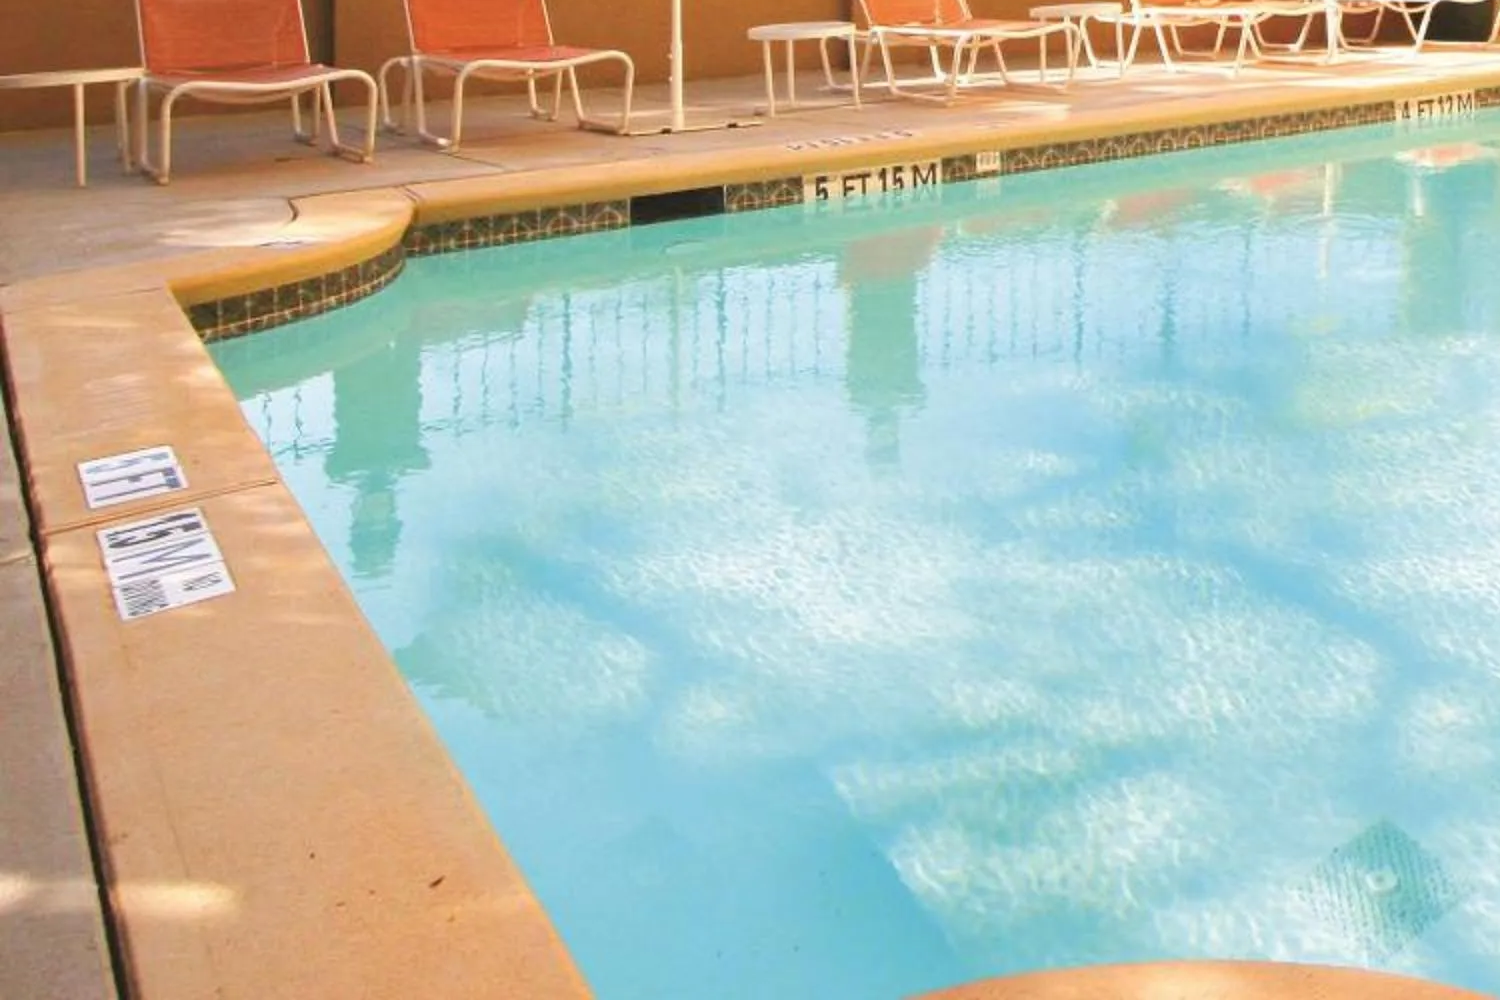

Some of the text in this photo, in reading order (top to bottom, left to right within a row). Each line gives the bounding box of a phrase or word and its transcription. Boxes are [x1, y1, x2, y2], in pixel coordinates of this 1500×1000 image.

[815, 175, 829, 201] 5
[841, 172, 872, 197] FT
[911, 162, 937, 189] M
